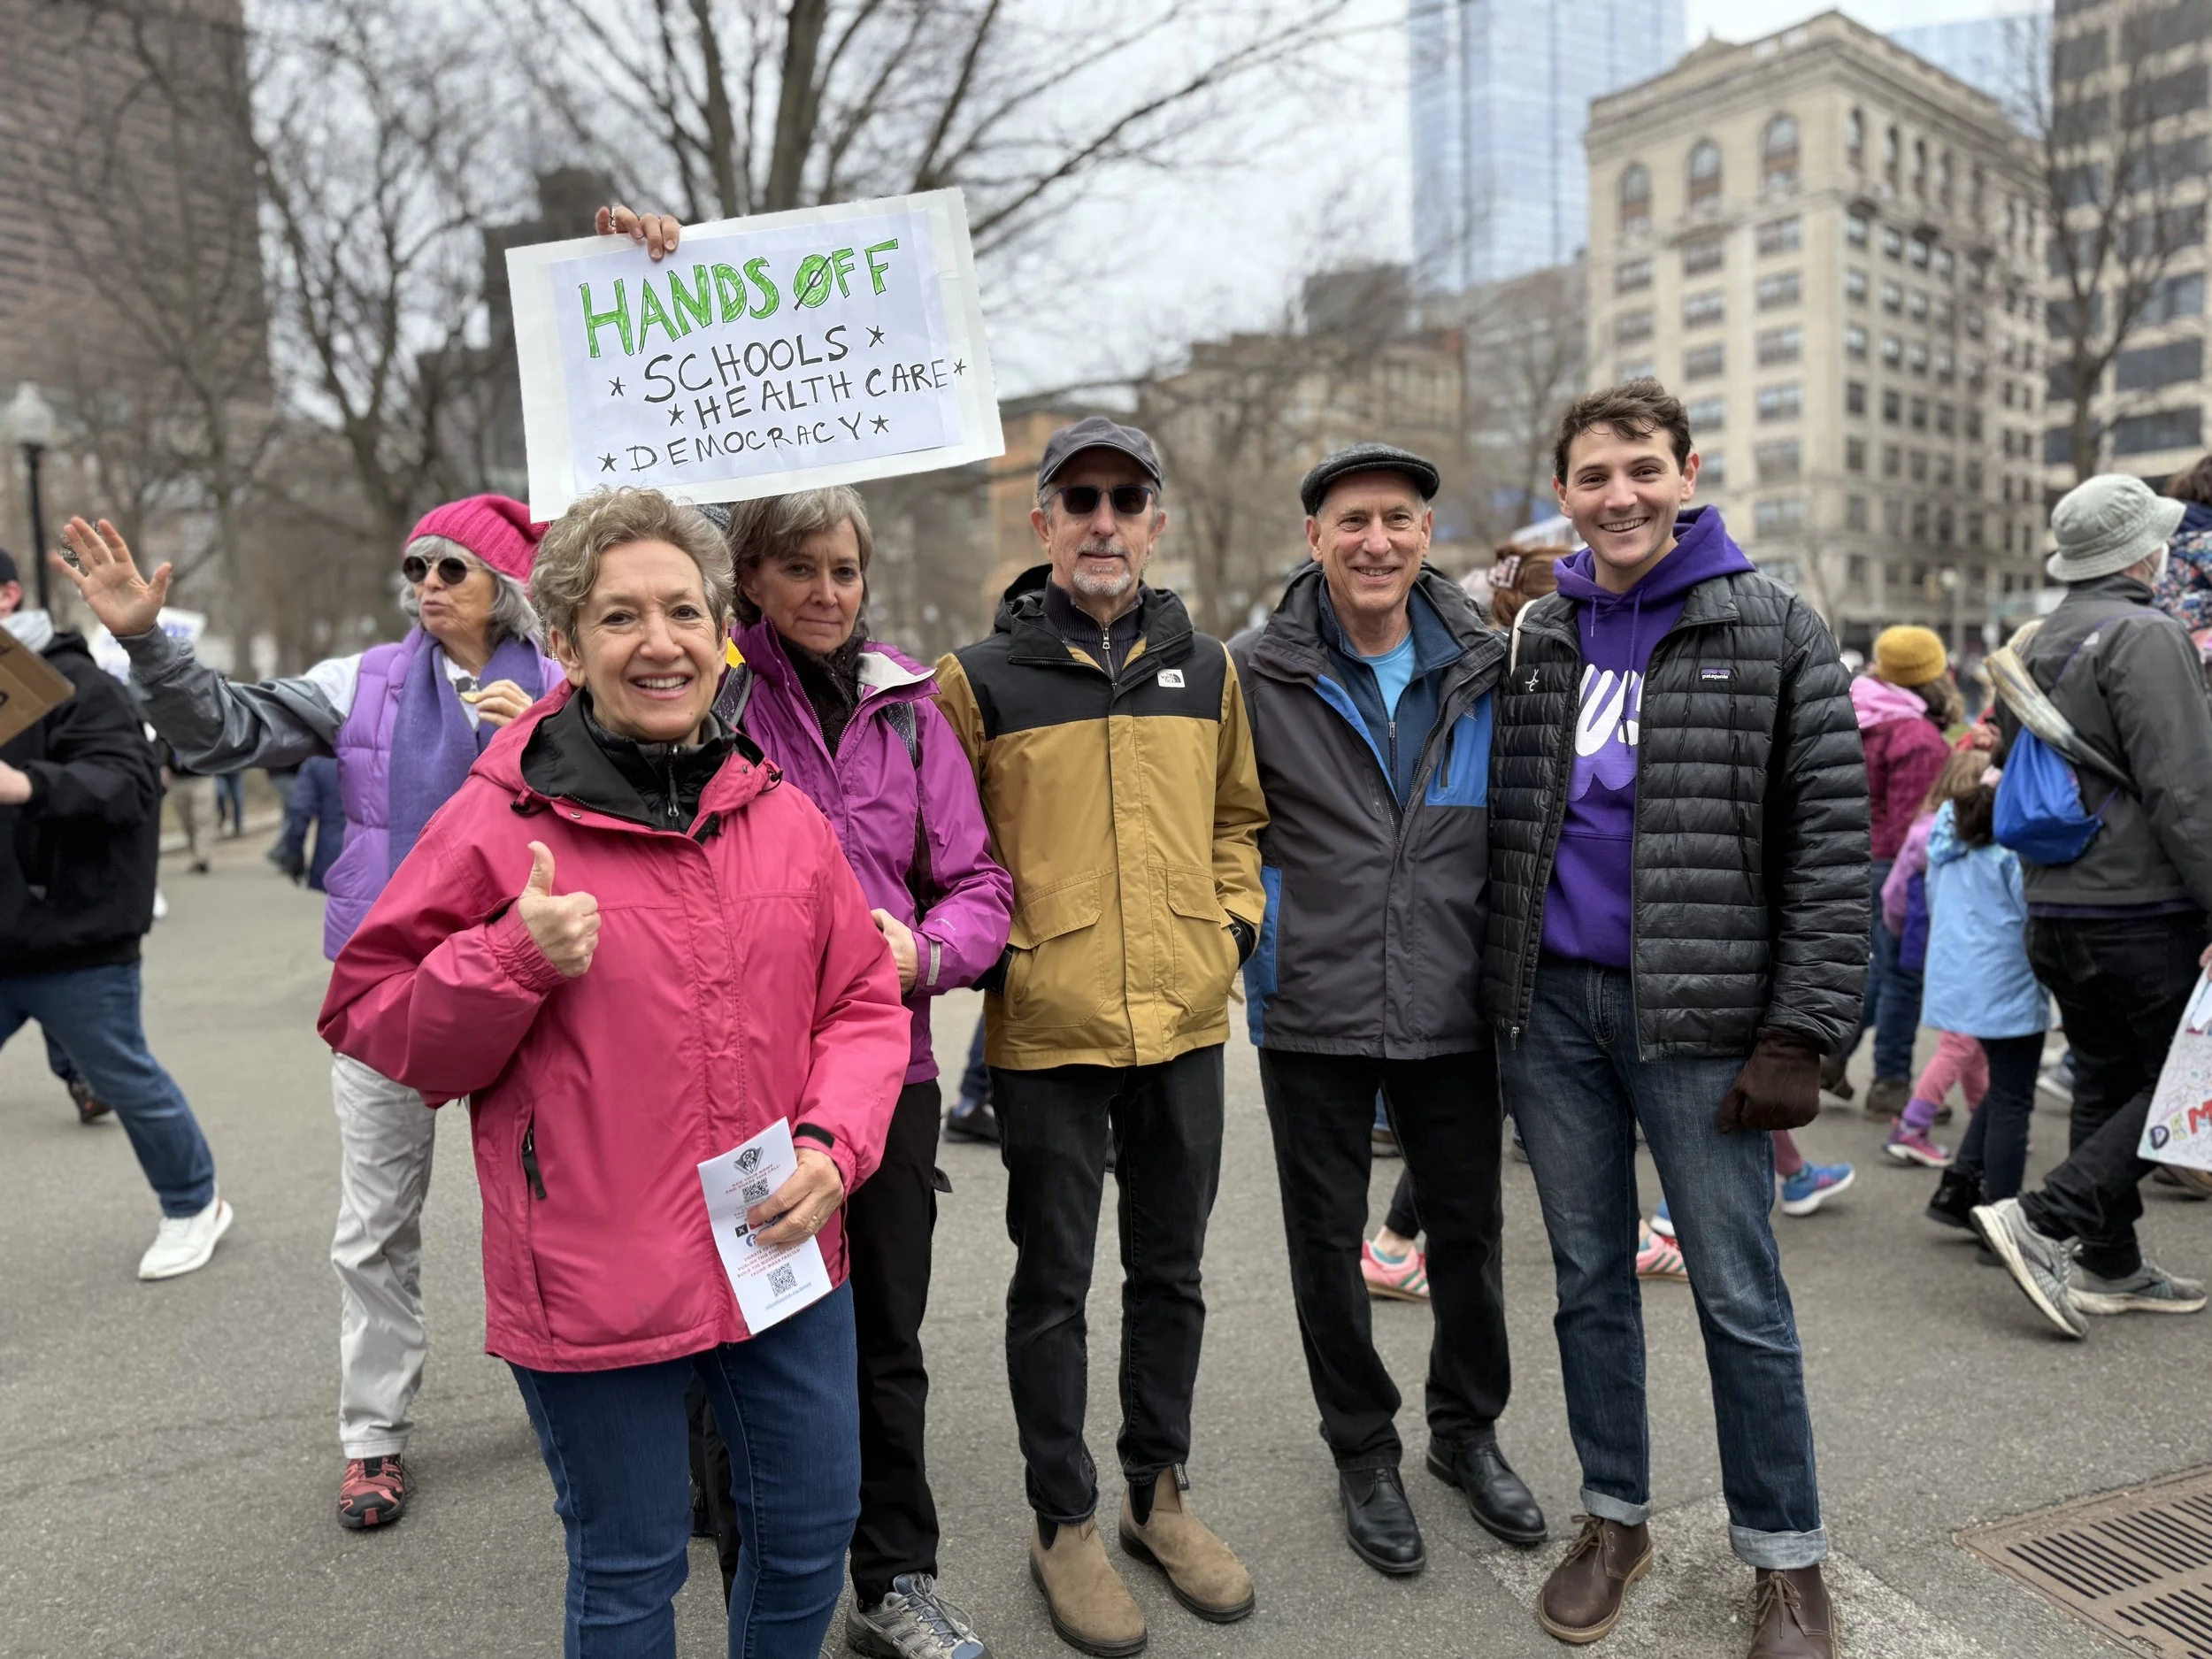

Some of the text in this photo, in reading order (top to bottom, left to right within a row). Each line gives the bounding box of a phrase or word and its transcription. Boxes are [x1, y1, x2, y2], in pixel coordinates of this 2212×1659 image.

[578, 238, 899, 358] HANDS OFF
[643, 324, 849, 403] SCHOOLS
[696, 358, 949, 429] HEALTH CARE
[626, 411, 862, 472] DEMOCRACY
